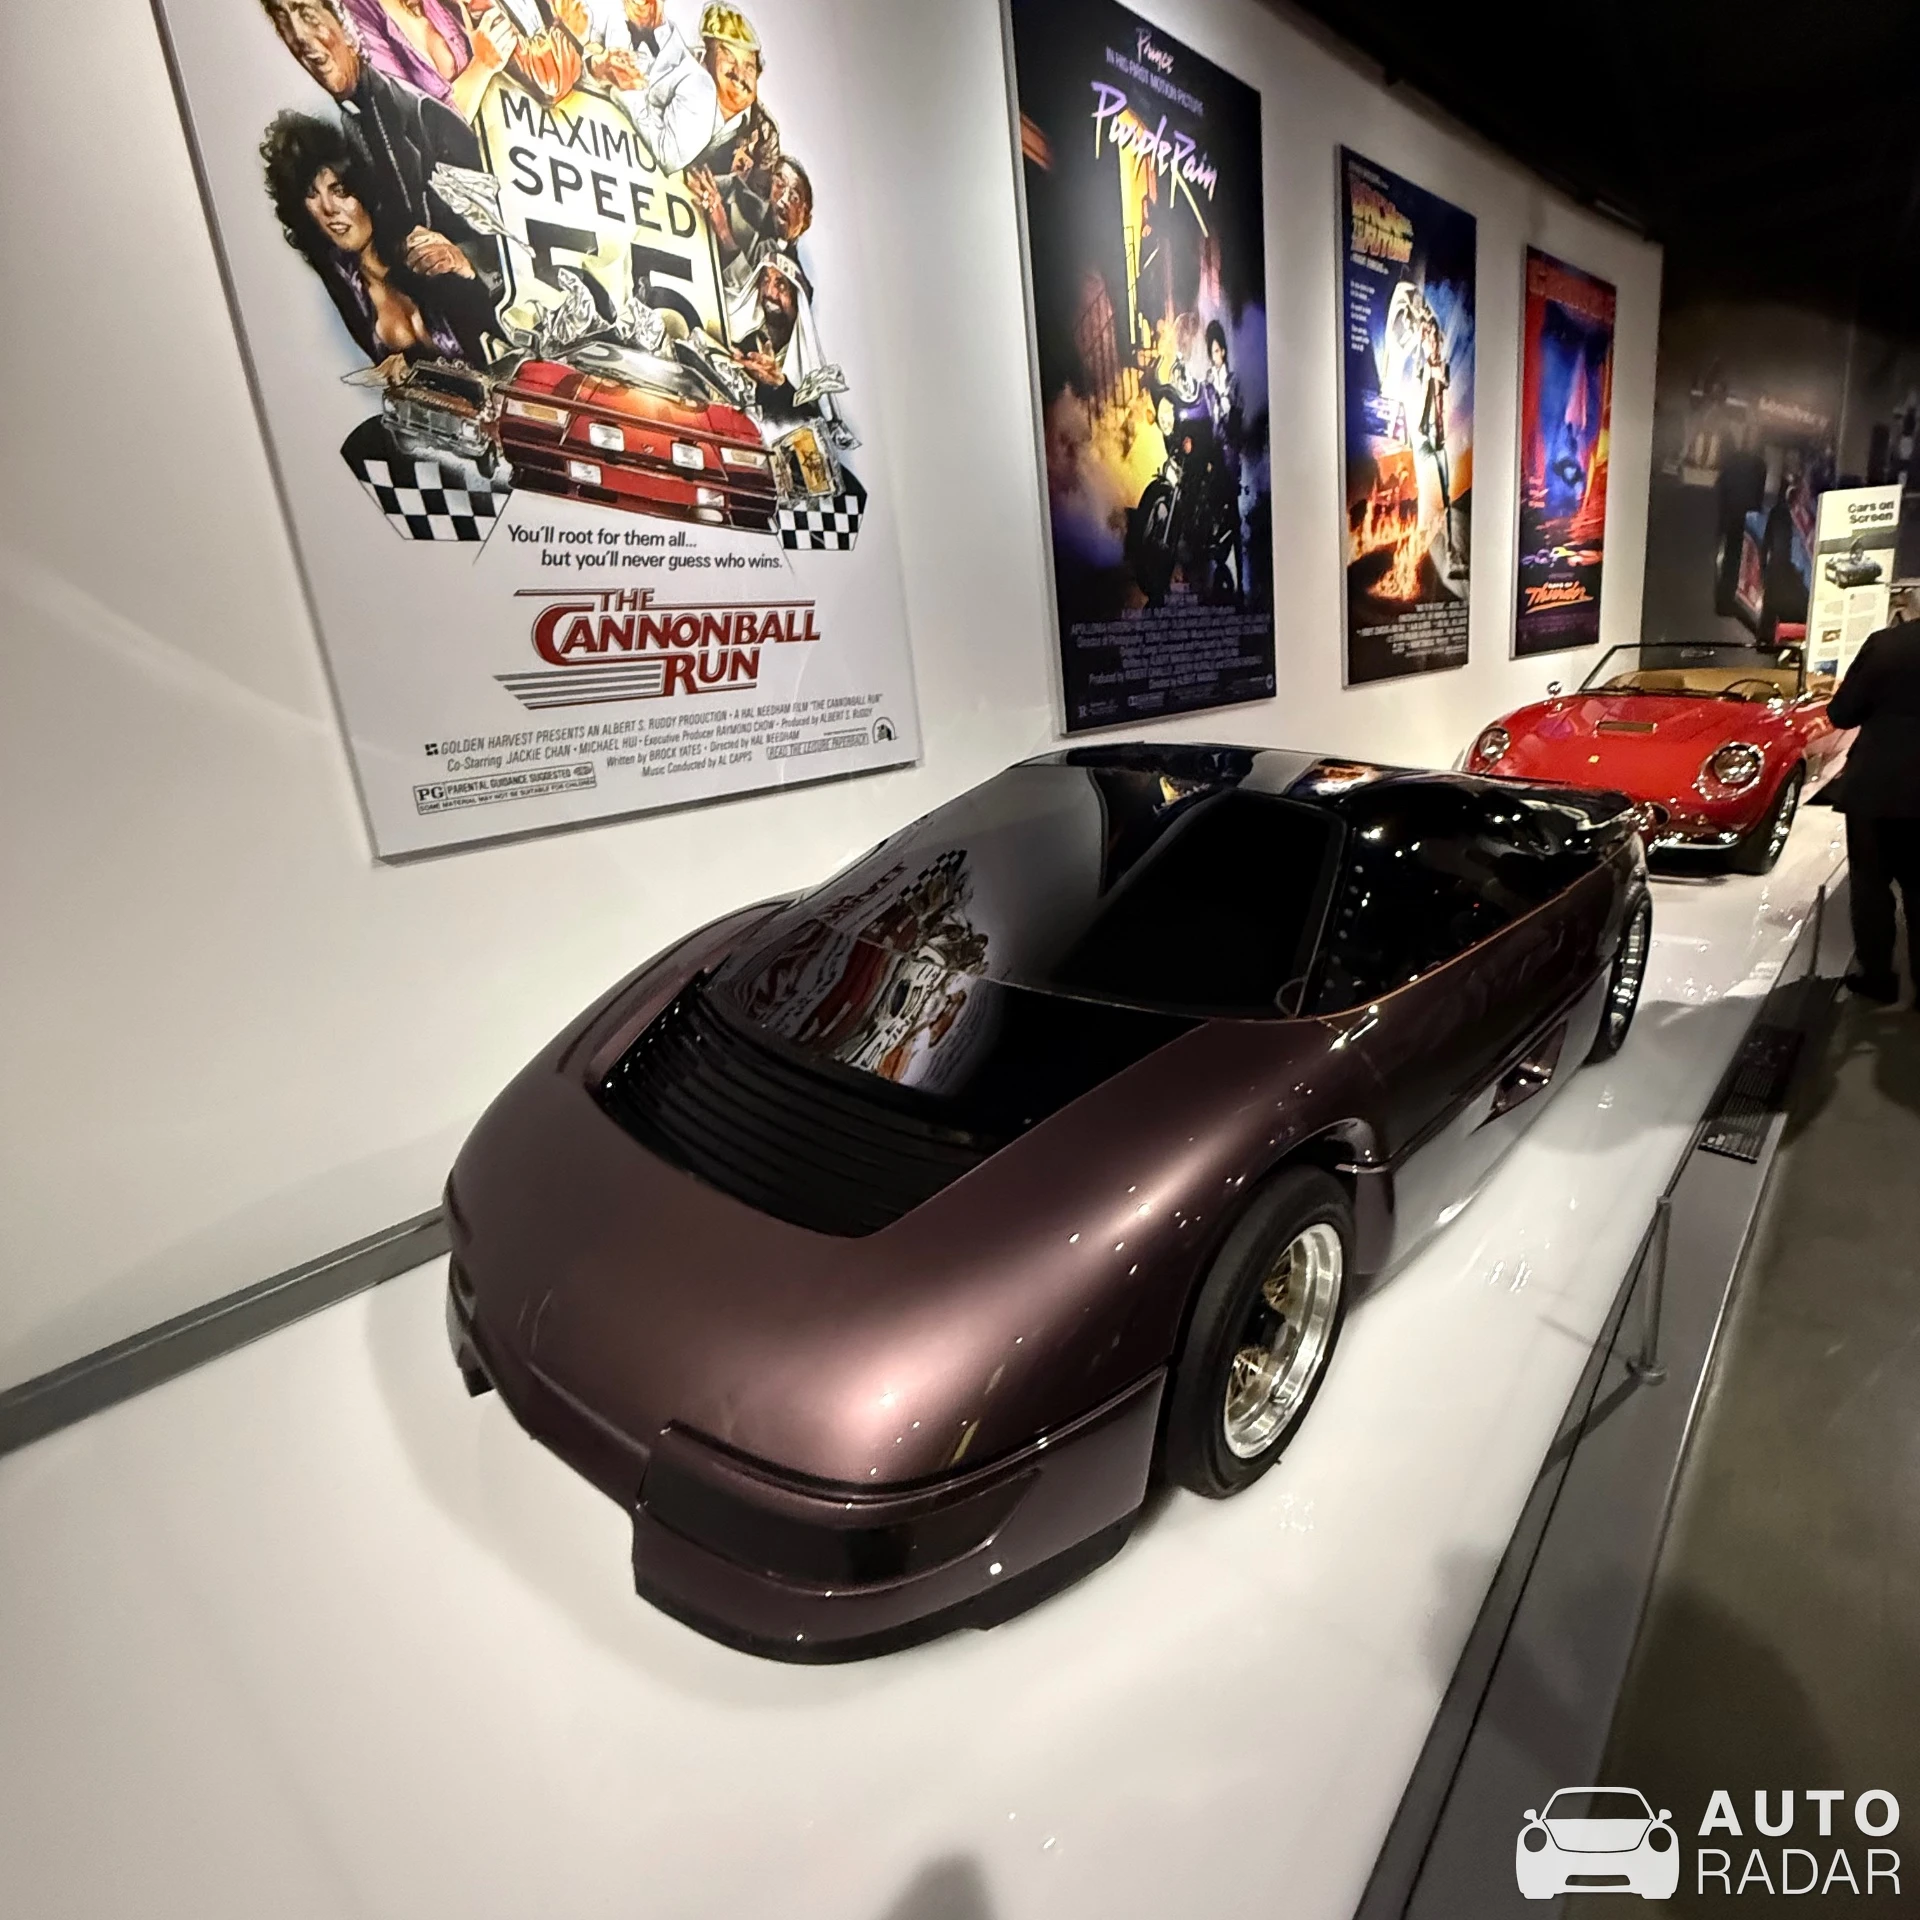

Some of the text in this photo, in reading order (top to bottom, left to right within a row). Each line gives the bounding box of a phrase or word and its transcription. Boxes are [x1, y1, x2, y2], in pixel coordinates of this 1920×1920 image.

[499, 88, 657, 172] MAXIMU
[1091, 80, 1217, 237] Purple Rain
[508, 145, 697, 239] SPEED
[525, 217, 704, 331] 55
[1848, 501, 1894, 513] Cars on
[1849, 512, 1893, 524] Screen
[508, 524, 697, 548] You'll root for them all...
[541, 549, 783, 570] but you'll never guess who wins.
[600, 588, 654, 611] THE
[531, 602, 821, 666] CANNONBALL
[661, 647, 760, 696] RUN
[441, 738, 485, 755] GOLDEN
[488, 731, 534, 748] HARVEST
[536, 727, 585, 743] PRESENTS
[587, 725, 599, 736] AN
[602, 720, 635, 735] ALBERT
[649, 716, 677, 730] RUDDY
[679, 710, 727, 726] PRODUCTION
[734, 708, 739, 719] A
[741, 707, 755, 718] HAL
[757, 703, 791, 716] NEEDHAM
[793, 700, 808, 712] FILM
[827, 694, 866, 708] CANNONBALL
[447, 755, 502, 772] Co-Starring
[506, 747, 541, 764] JACKIE
[545, 744, 571, 759] CHAN
[579, 739, 619, 754] MICHAEL
[622, 736, 637, 748] HUI
[644, 734, 680, 746] Executive
[682, 728, 714, 741] Producer
[716, 722, 751, 736] RAYMOND
[754, 720, 774, 731] CHOW
[782, 715, 810, 729] Produced
[812, 715, 818, 725] by
[820, 710, 844, 723] ALBERT
[607, 730, 799, 767] Written by BROCK YATES Directed by HAL NEEDHAM
[790, 744, 801, 755] THE
[832, 733, 866, 747] PAPERBACK
[642, 751, 753, 777] Music Conducted by AL CAPPS
[418, 769, 571, 801] PG PARENTAL GUIDANCE SUGGESTED
[419, 803, 441, 812] SOME
[443, 798, 477, 808] MATERIAL
